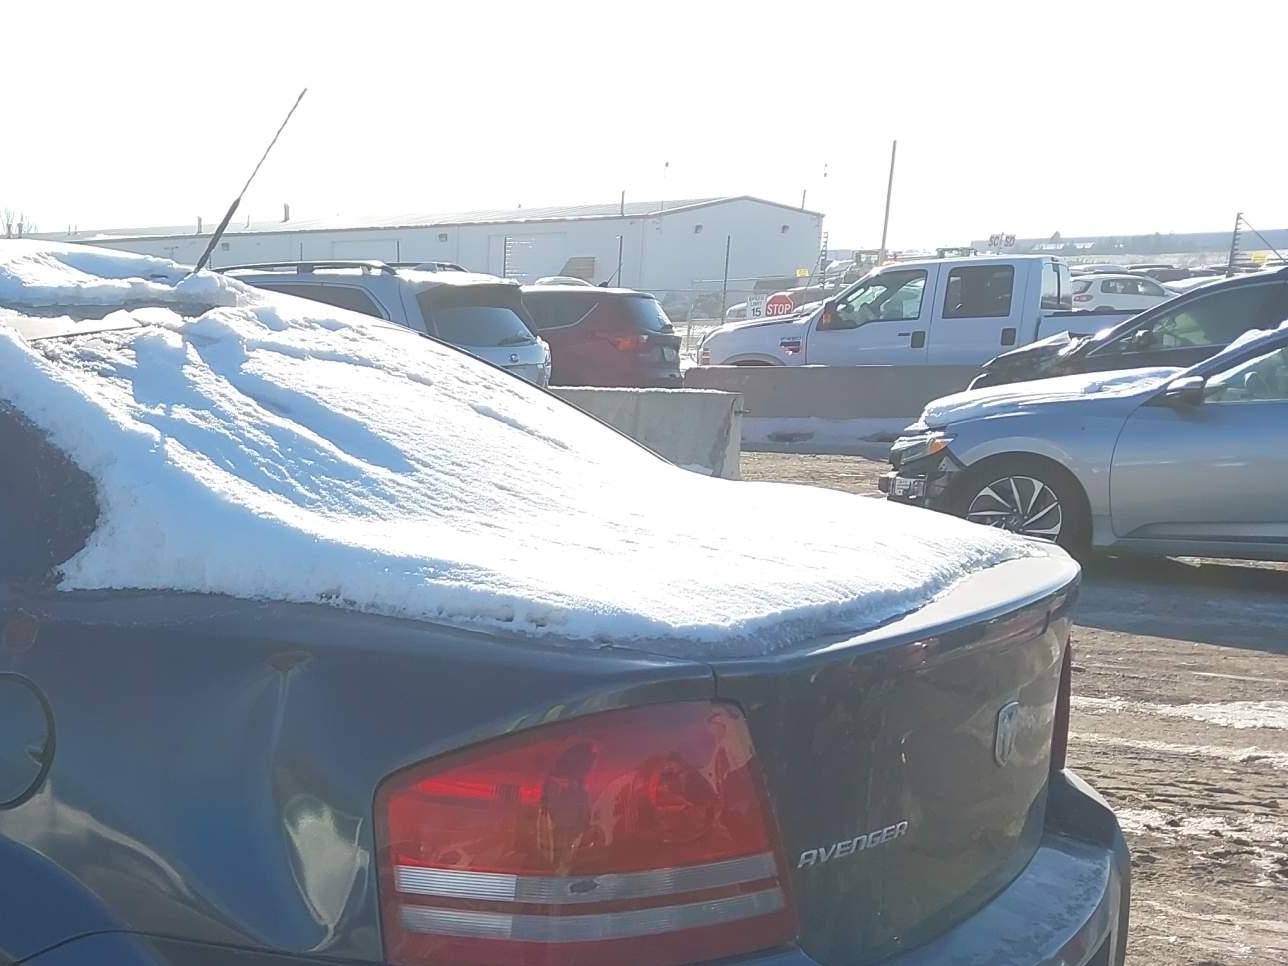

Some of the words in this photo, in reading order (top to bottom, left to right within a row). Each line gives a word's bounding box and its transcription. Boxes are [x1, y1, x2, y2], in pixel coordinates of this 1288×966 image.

[752, 307, 762, 317] 15
[767, 303, 792, 316] STOP
[797, 820, 909, 868] AVENGER
